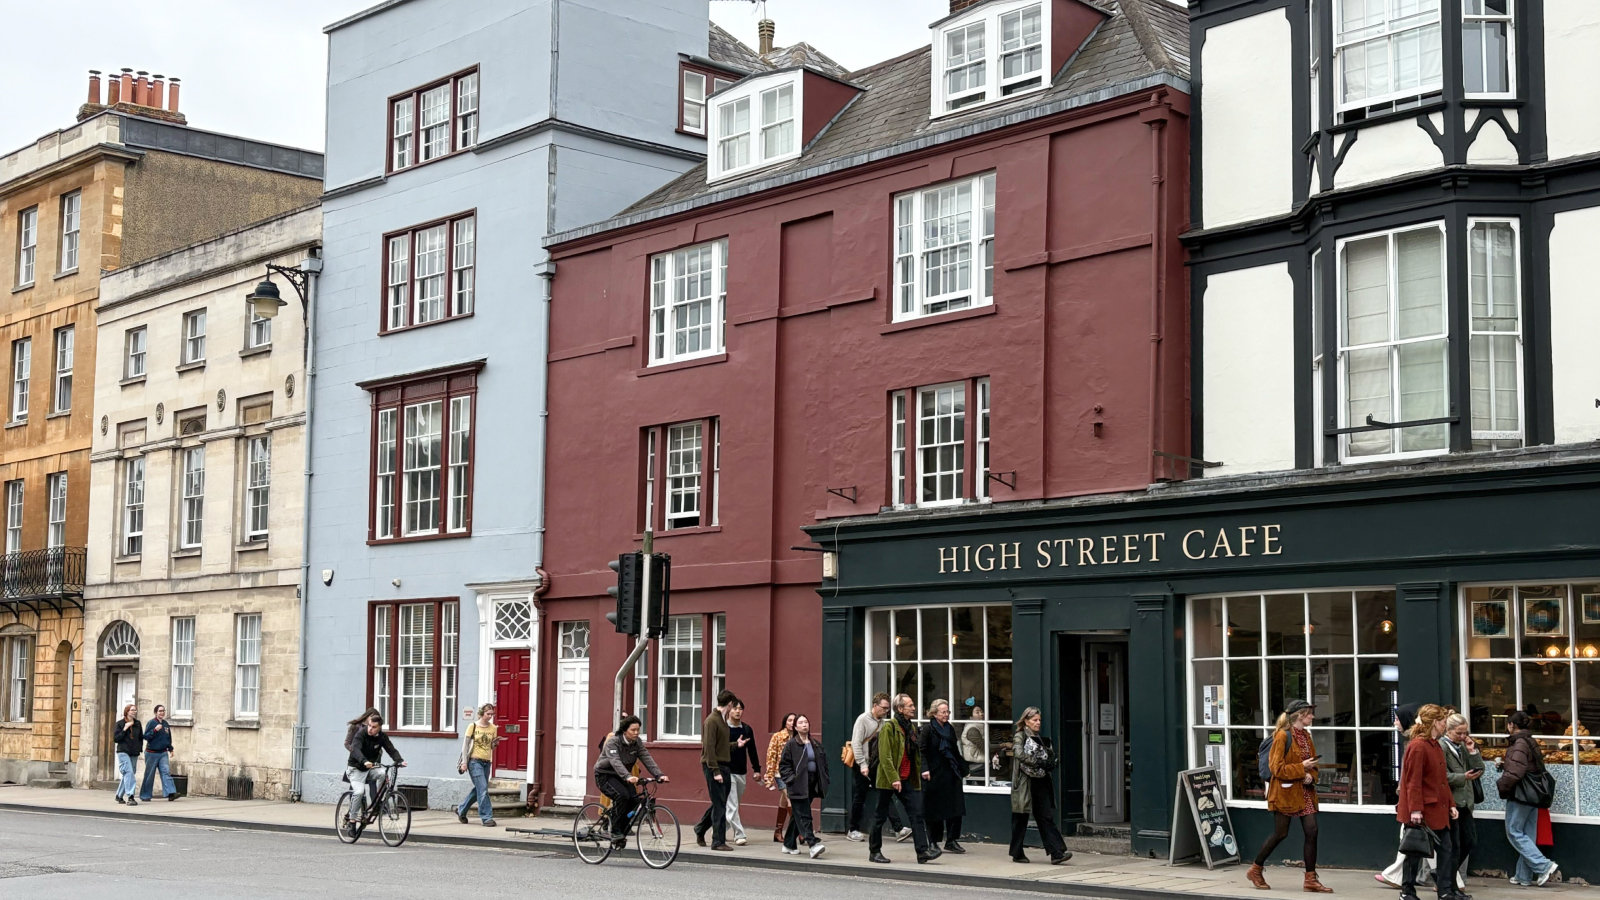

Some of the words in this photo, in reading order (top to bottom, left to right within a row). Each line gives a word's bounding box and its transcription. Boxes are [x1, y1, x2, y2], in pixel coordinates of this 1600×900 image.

[938, 541, 1022, 574] HIGH
[1036, 532, 1166, 569] STREET
[1182, 524, 1284, 560] CAFE
